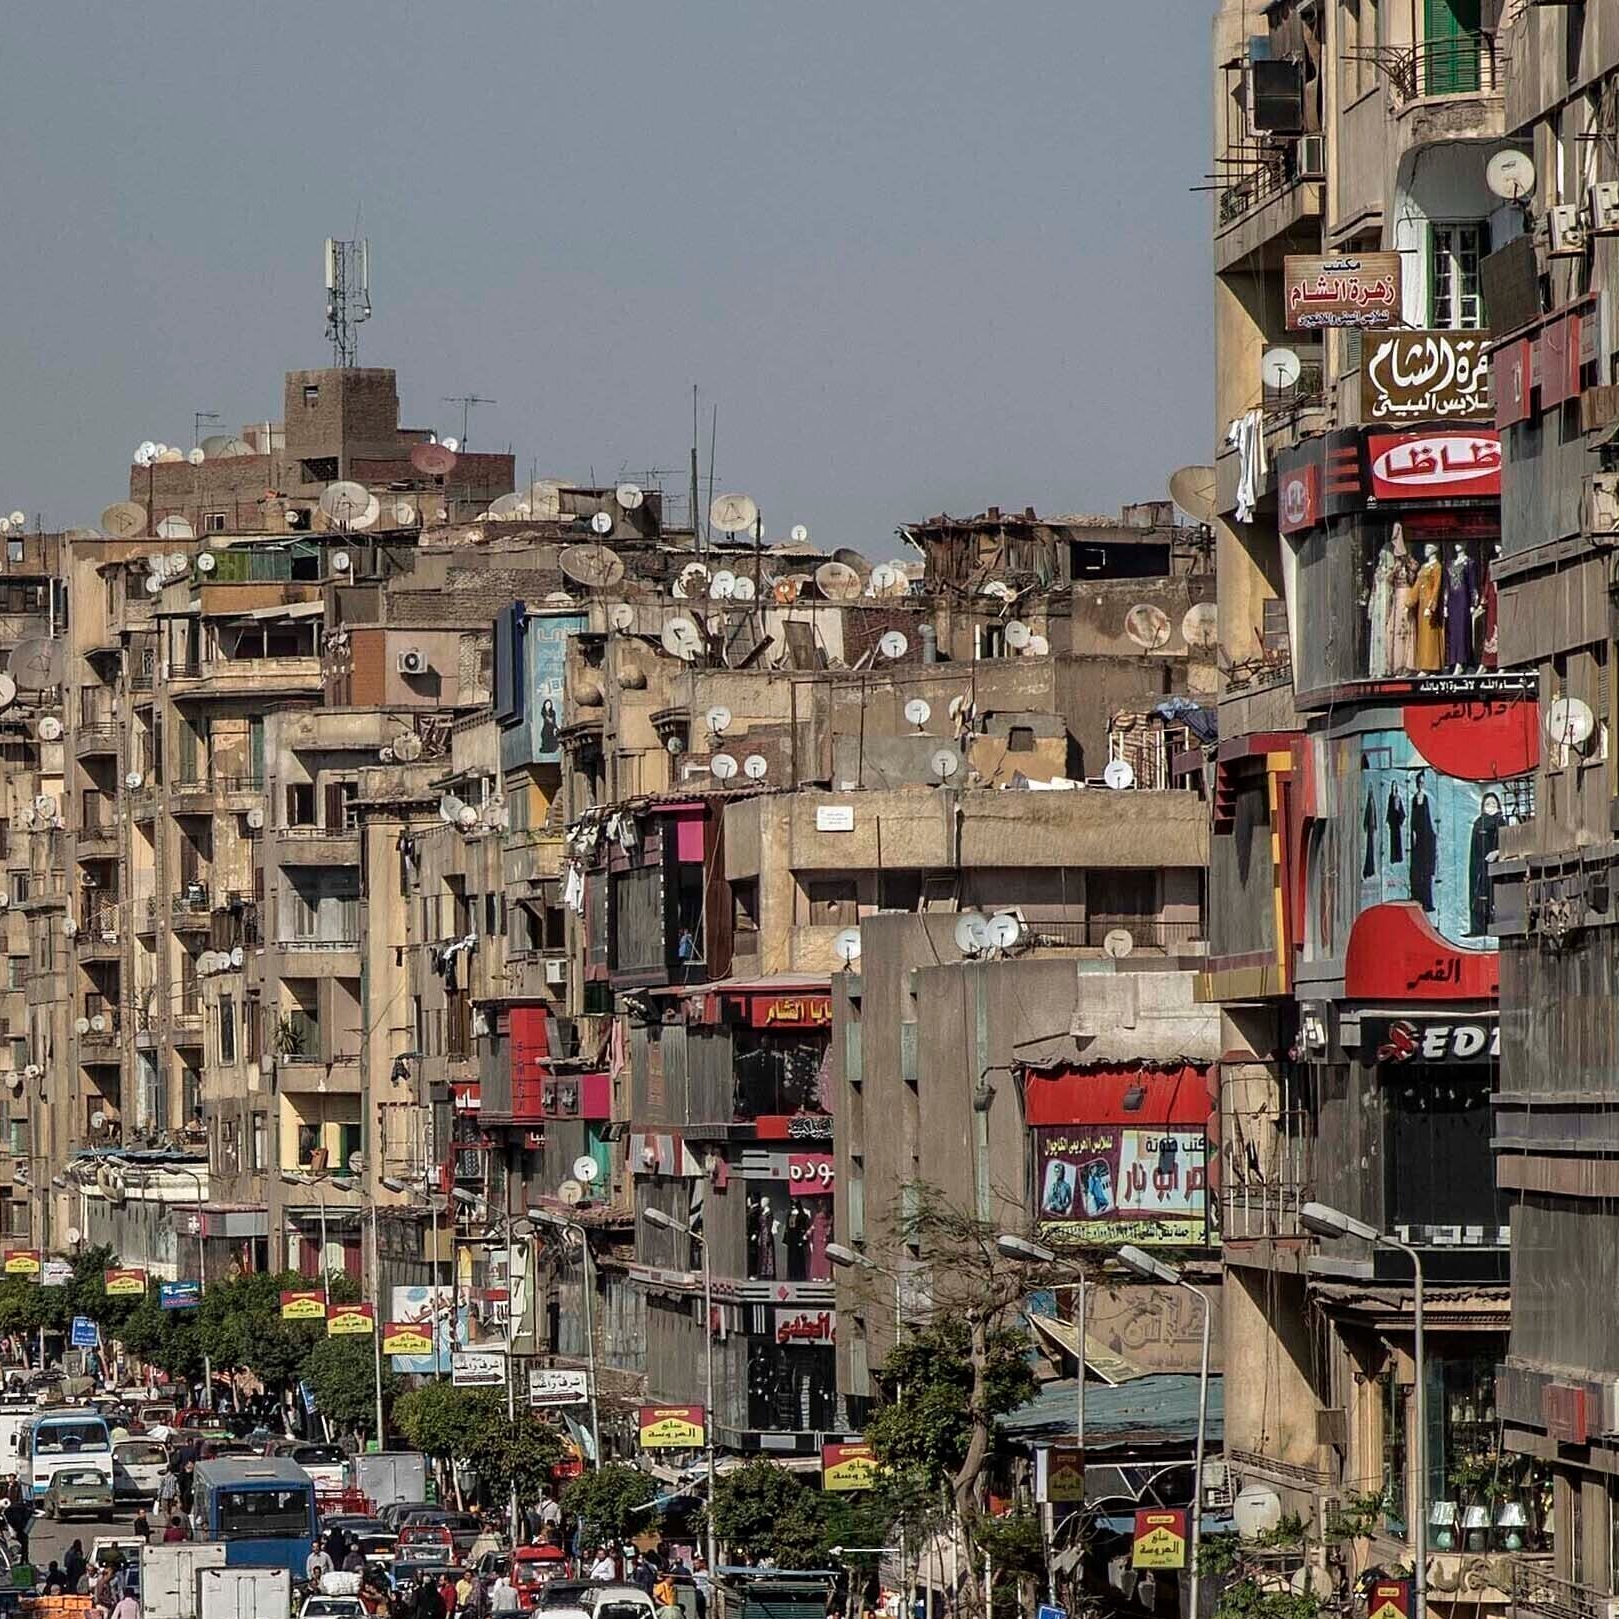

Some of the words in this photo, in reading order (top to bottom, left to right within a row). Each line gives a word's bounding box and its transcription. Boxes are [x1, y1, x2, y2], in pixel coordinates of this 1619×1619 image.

[1323, 258, 1361, 275] مكتب
[1290, 275, 1346, 310] الشام
[1351, 275, 1396, 309] زهرة
[1369, 337, 1455, 393] الشام
